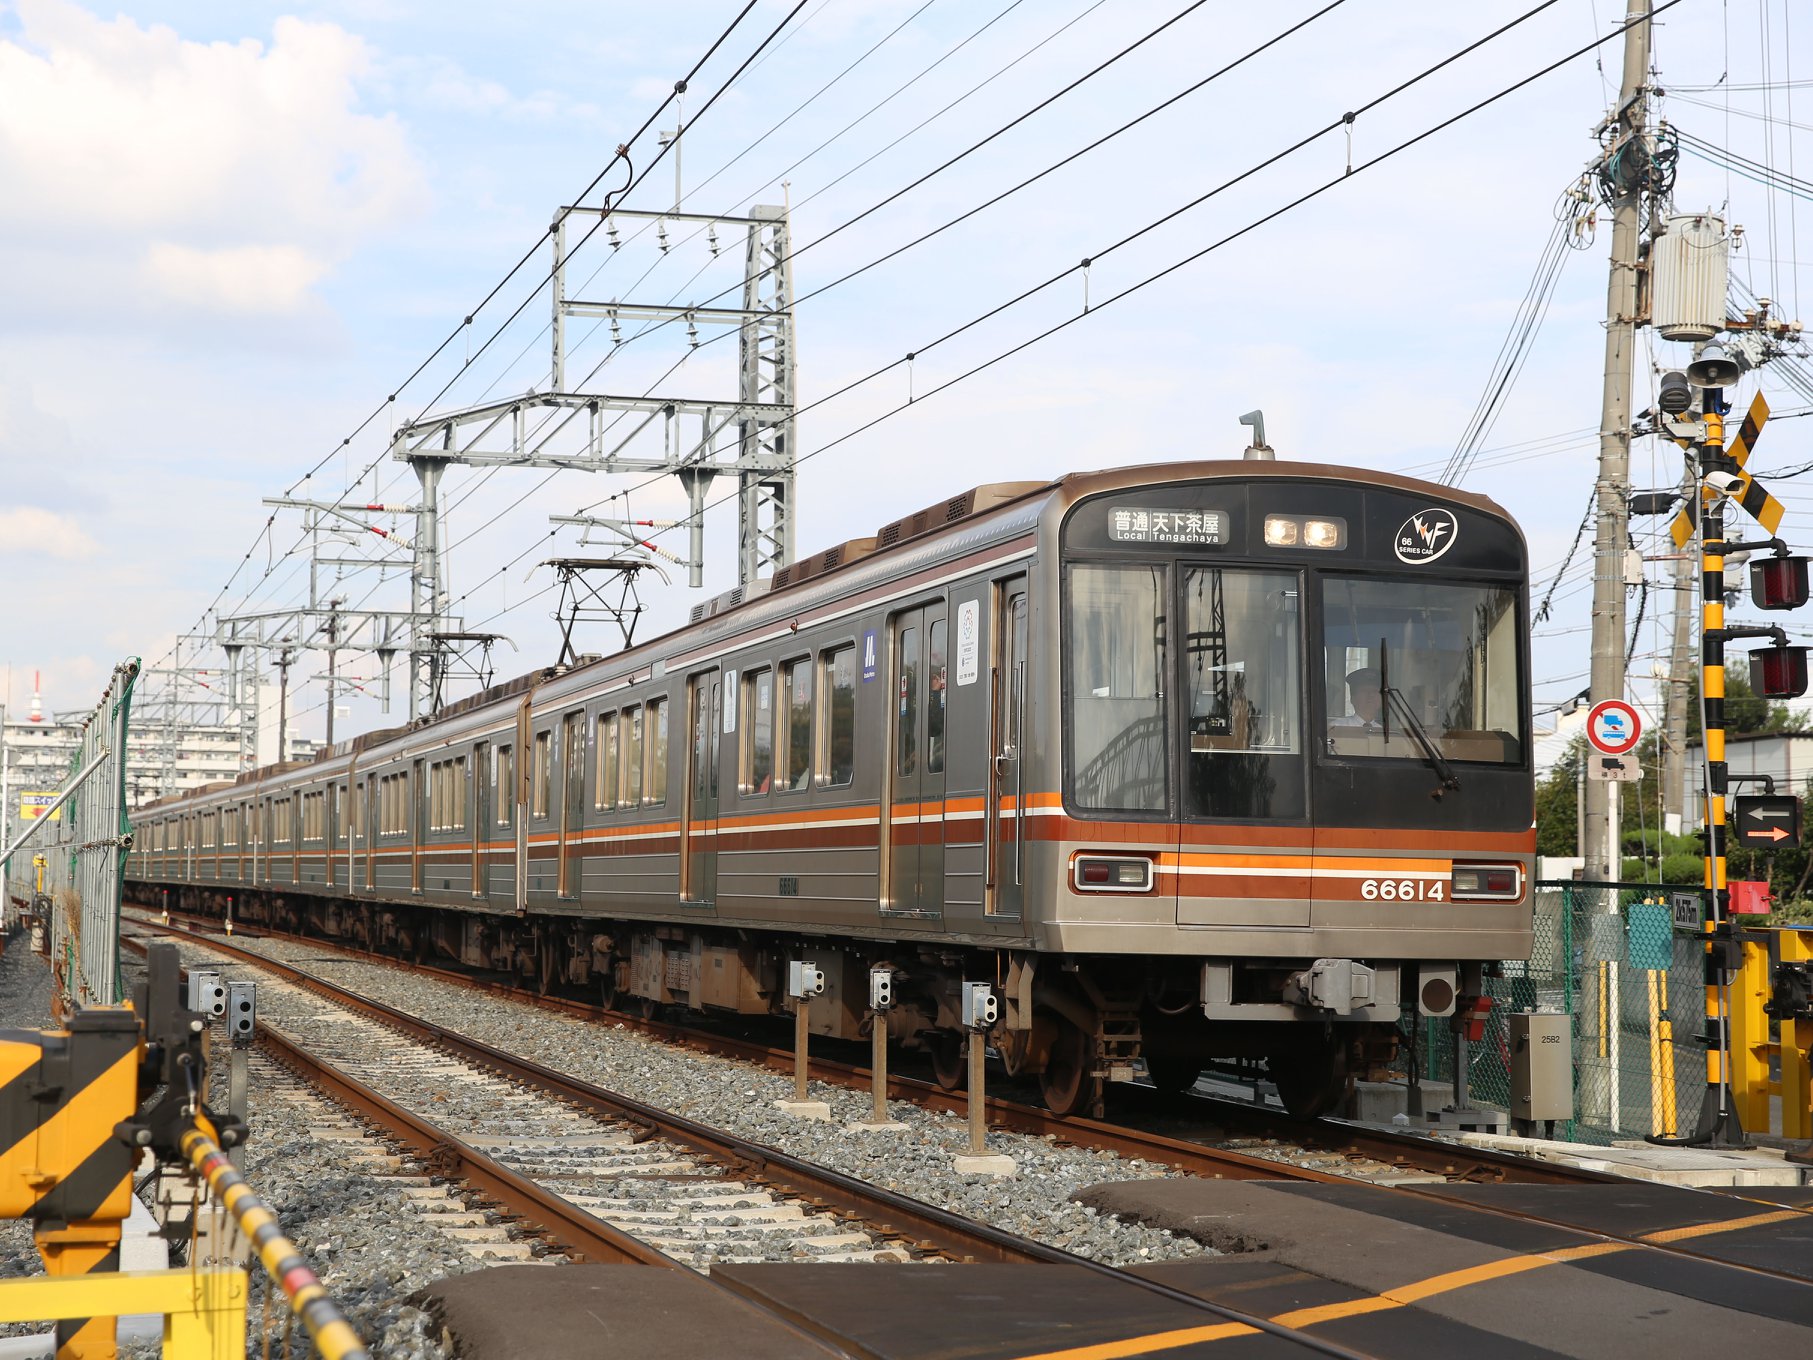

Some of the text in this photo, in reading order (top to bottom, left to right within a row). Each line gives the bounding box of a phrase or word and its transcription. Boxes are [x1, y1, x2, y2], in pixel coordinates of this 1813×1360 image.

[1114, 510, 1219, 534] 普通 天下茶屋
[1117, 531, 1219, 543] Local Tengachaya
[1401, 537, 1412, 546] 66
[1399, 546, 1420, 554] SERIES
[1361, 879, 1444, 902] 66614
[1541, 1035, 1560, 1044] 2582
